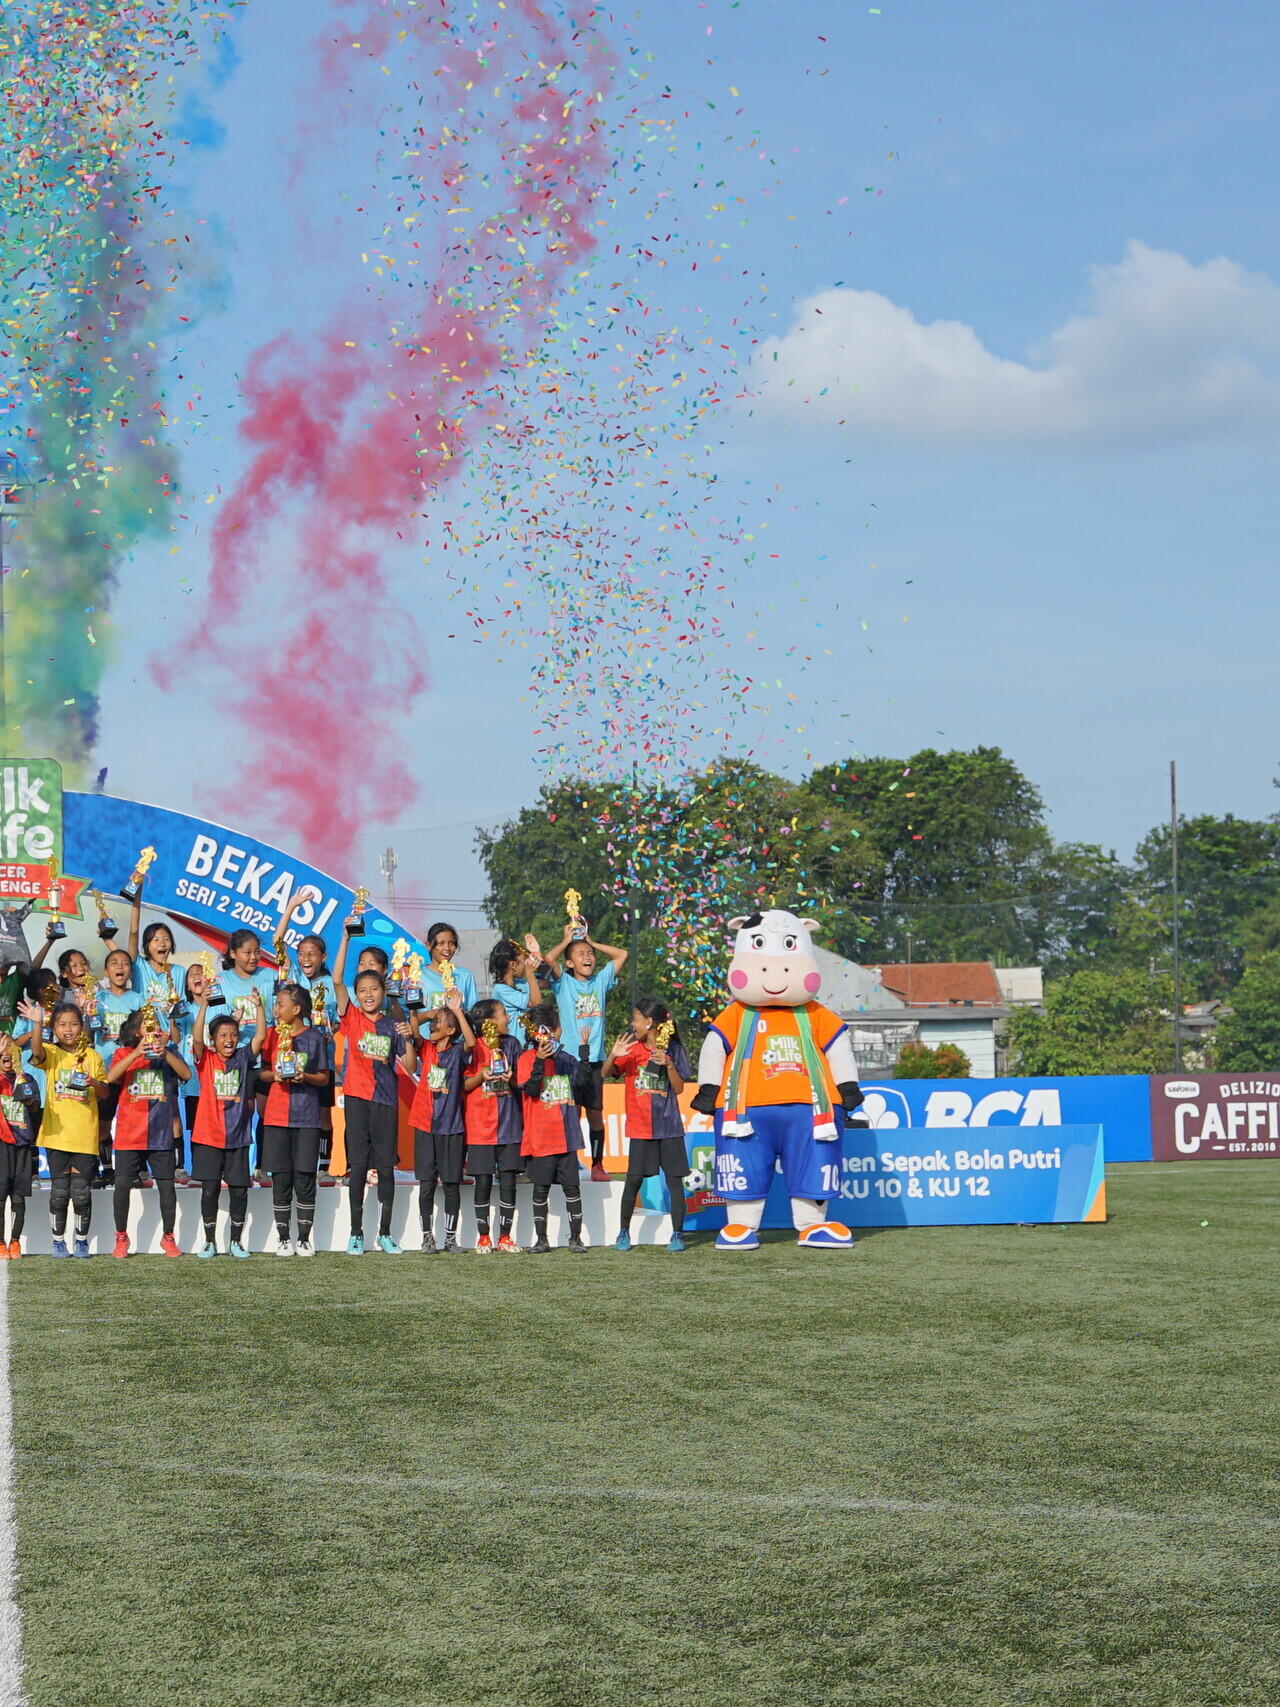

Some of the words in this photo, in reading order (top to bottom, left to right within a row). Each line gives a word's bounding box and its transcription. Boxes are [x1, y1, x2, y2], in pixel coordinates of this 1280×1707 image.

[185, 834, 338, 935] BEKASI
[176, 879, 216, 907] SERI
[216, 895, 231, 912] 2
[230, 902, 306, 950] 2025-02
[768, 1036, 800, 1051] Milk
[777, 1049, 802, 1063] Life
[881, 1150, 950, 1176] Sepak
[955, 1149, 1004, 1170] Bola
[1008, 1147, 1061, 1170] Putri
[717, 1173, 748, 1192] Life
[839, 1178, 869, 1199] KU
[875, 1178, 901, 1198] 10
[907, 1178, 924, 1198] &
[928, 1177, 961, 1197] KU
[966, 1176, 990, 1196] 12
